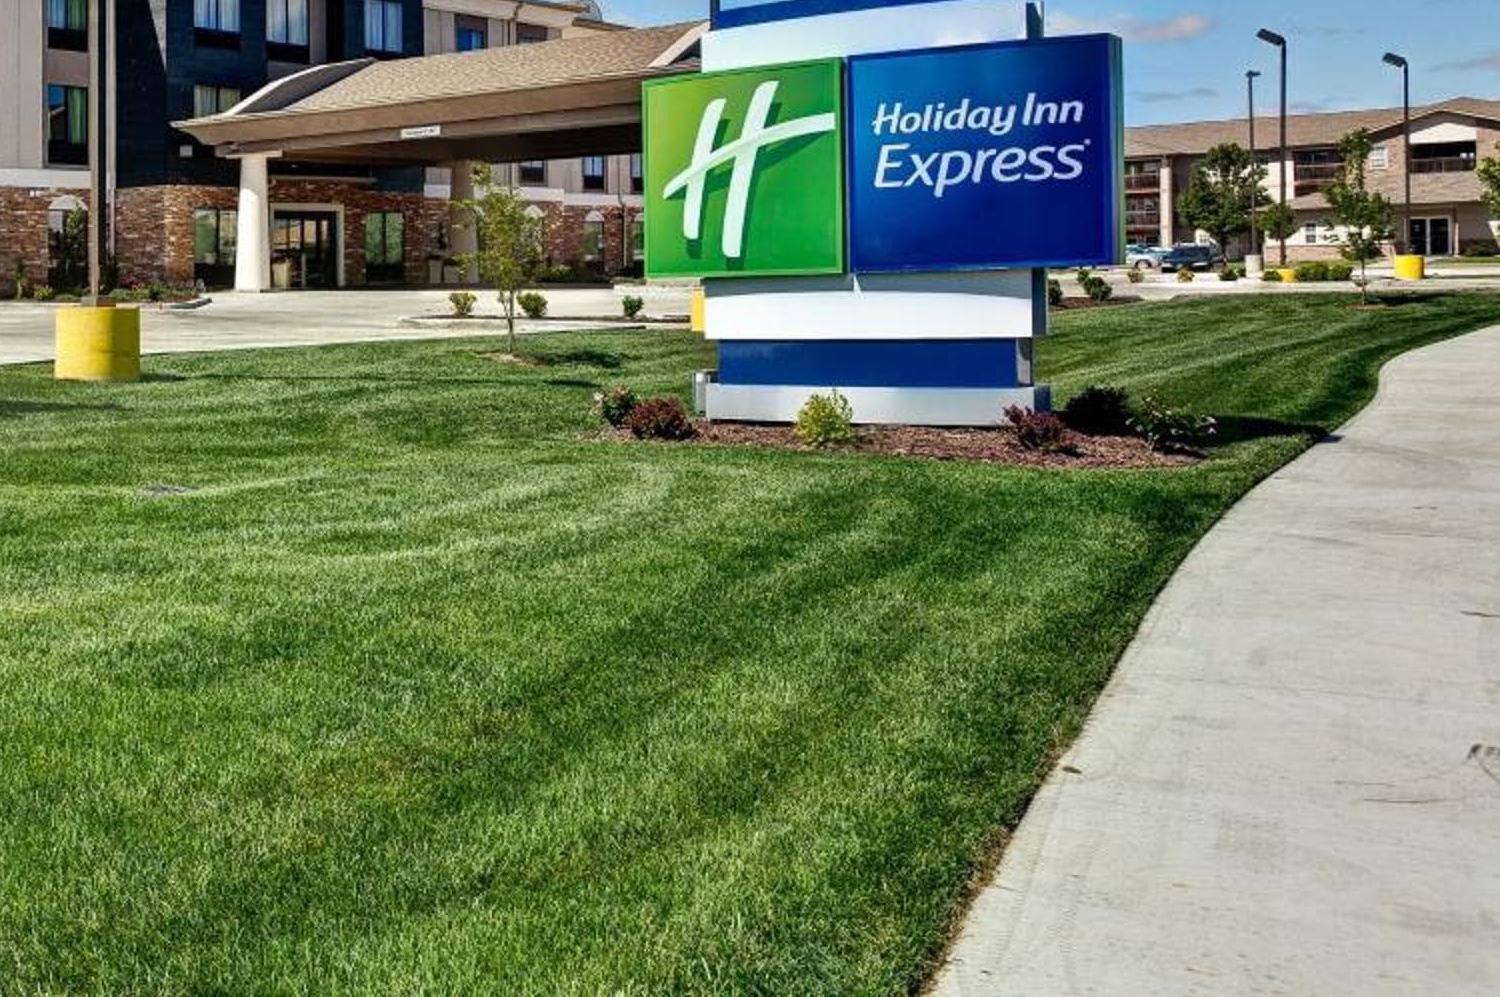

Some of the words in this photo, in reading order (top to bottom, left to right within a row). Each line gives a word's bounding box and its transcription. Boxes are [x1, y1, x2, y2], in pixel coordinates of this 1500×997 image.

[873, 98, 1017, 135] Holiday
[1023, 93, 1084, 125] Inn
[874, 142, 1086, 197] Express
